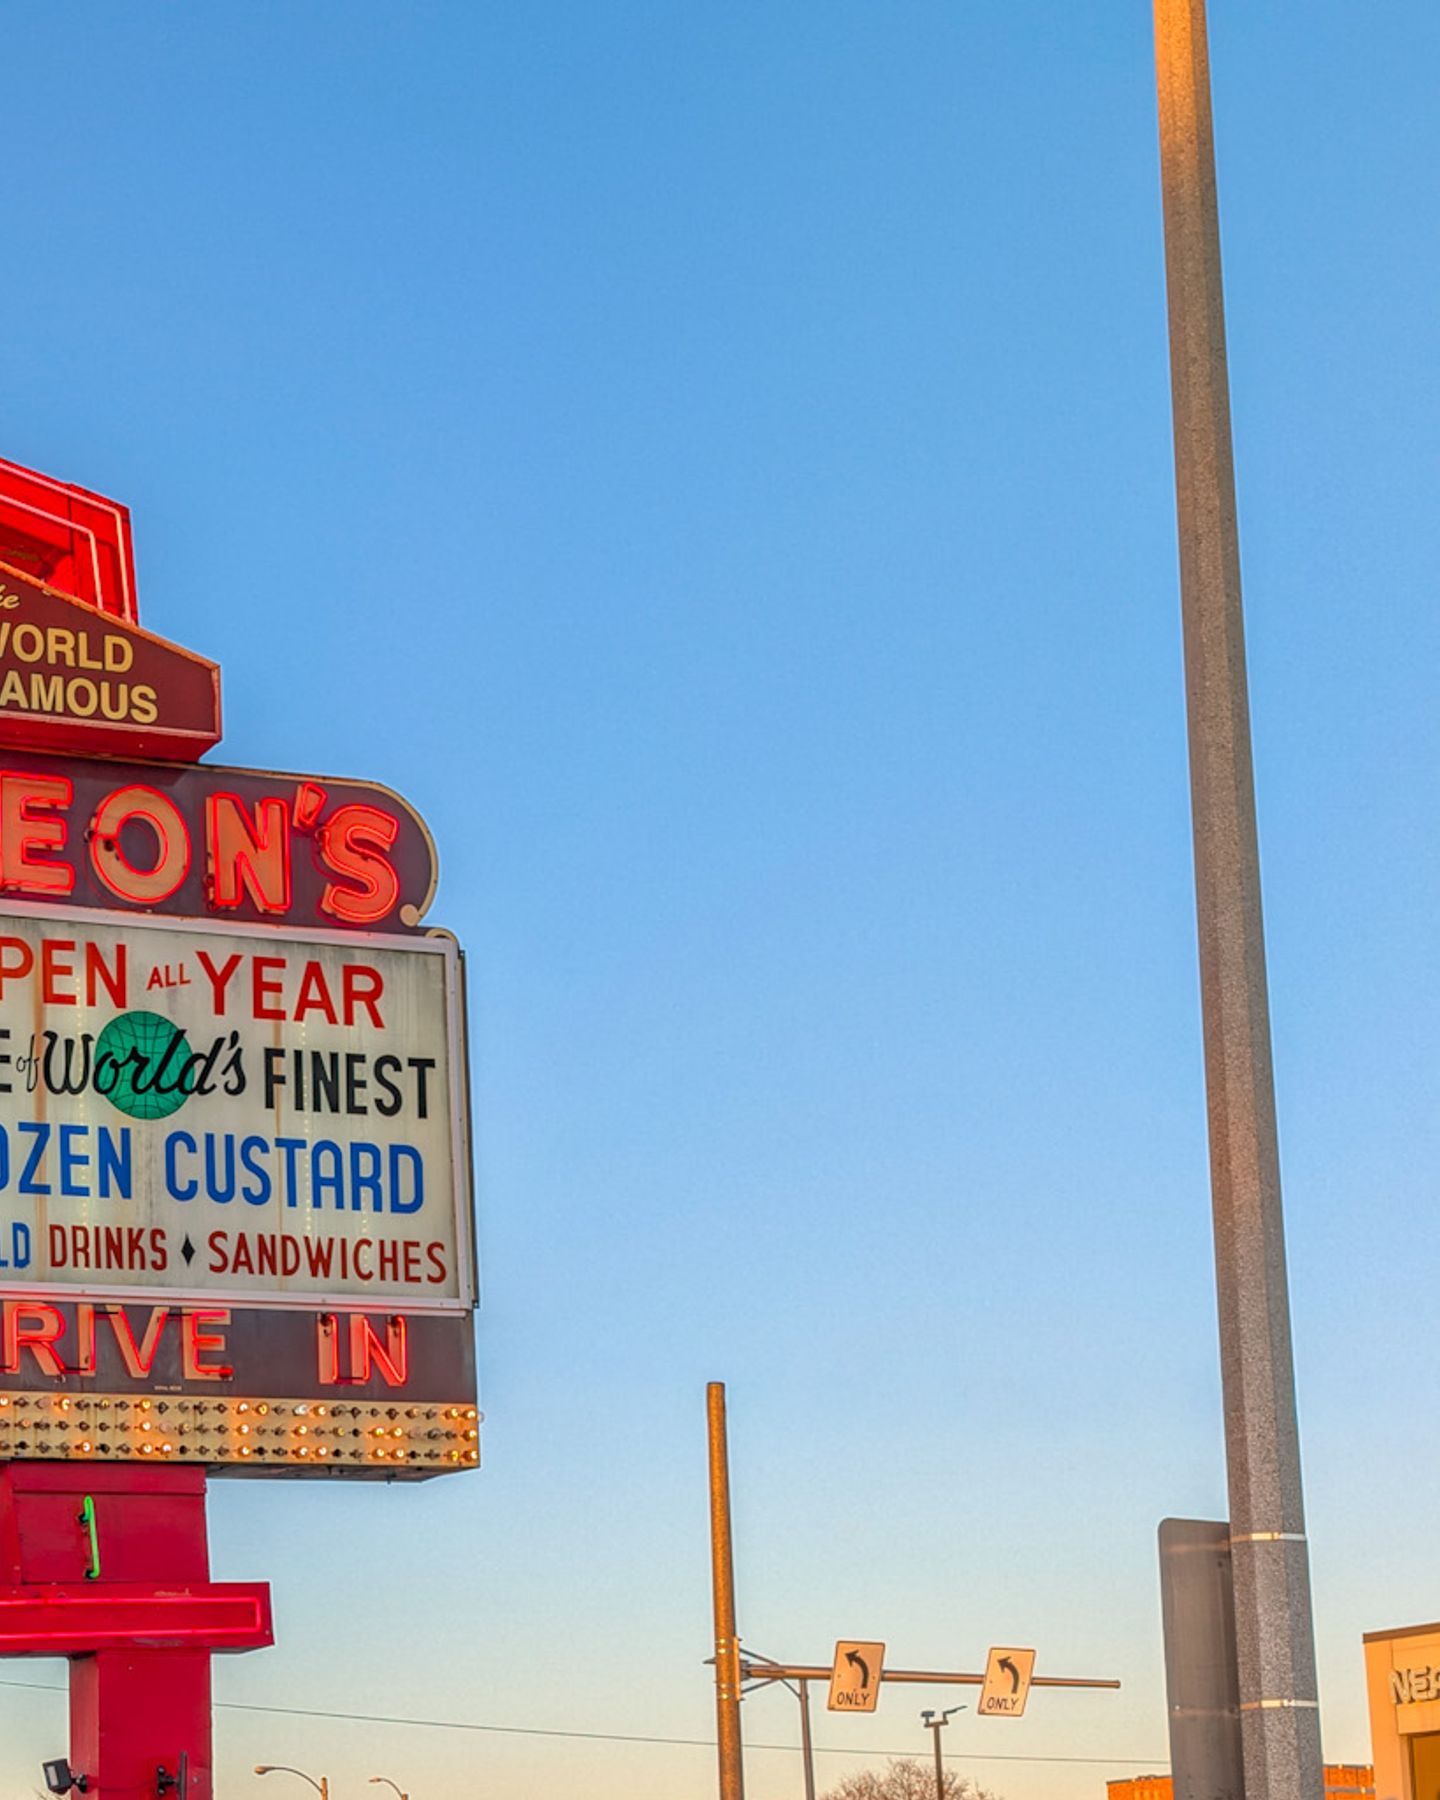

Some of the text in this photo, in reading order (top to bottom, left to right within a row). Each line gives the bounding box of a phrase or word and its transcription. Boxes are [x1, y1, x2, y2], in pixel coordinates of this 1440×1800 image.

[147, 963, 191, 991] ALL
[197, 951, 385, 1029] YEAR
[16, 1034, 40, 1092] of
[43, 1029, 246, 1095] World's
[265, 1048, 436, 1118] FINEST
[165, 1131, 424, 1213] CUSTARD
[49, 1224, 167, 1270] DRINKS
[208, 1231, 447, 1283] SANDWICHES
[316, 1312, 408, 1387] IN
[836, 1691, 871, 1707] ONLY
[986, 1696, 1019, 1711] ONLY
